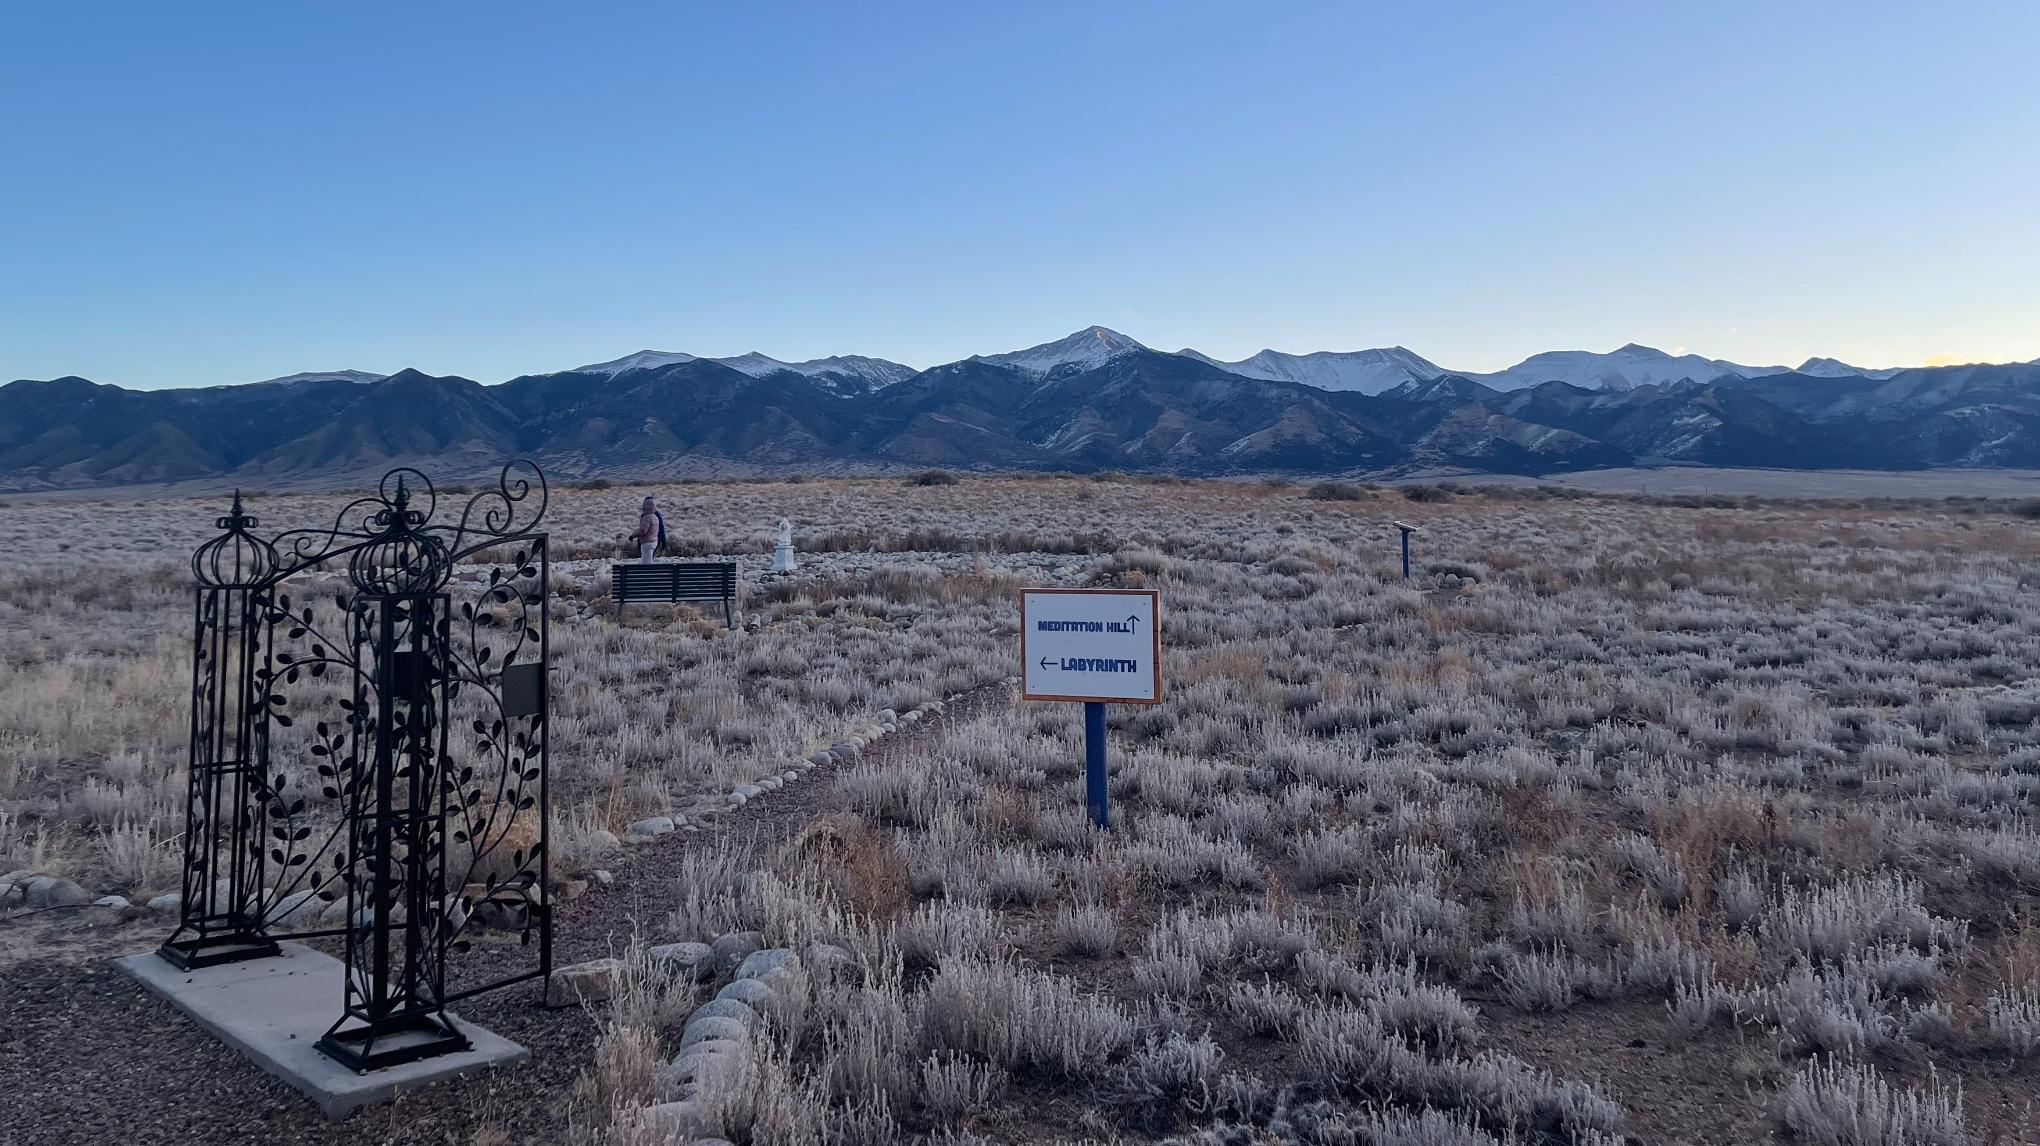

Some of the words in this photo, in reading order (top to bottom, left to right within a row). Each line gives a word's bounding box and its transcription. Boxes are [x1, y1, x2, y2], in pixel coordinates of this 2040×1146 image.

[1038, 621, 1103, 632] MEDITATION
[1106, 622, 1130, 633] HILL
[1060, 657, 1137, 673] LABYRINTH
